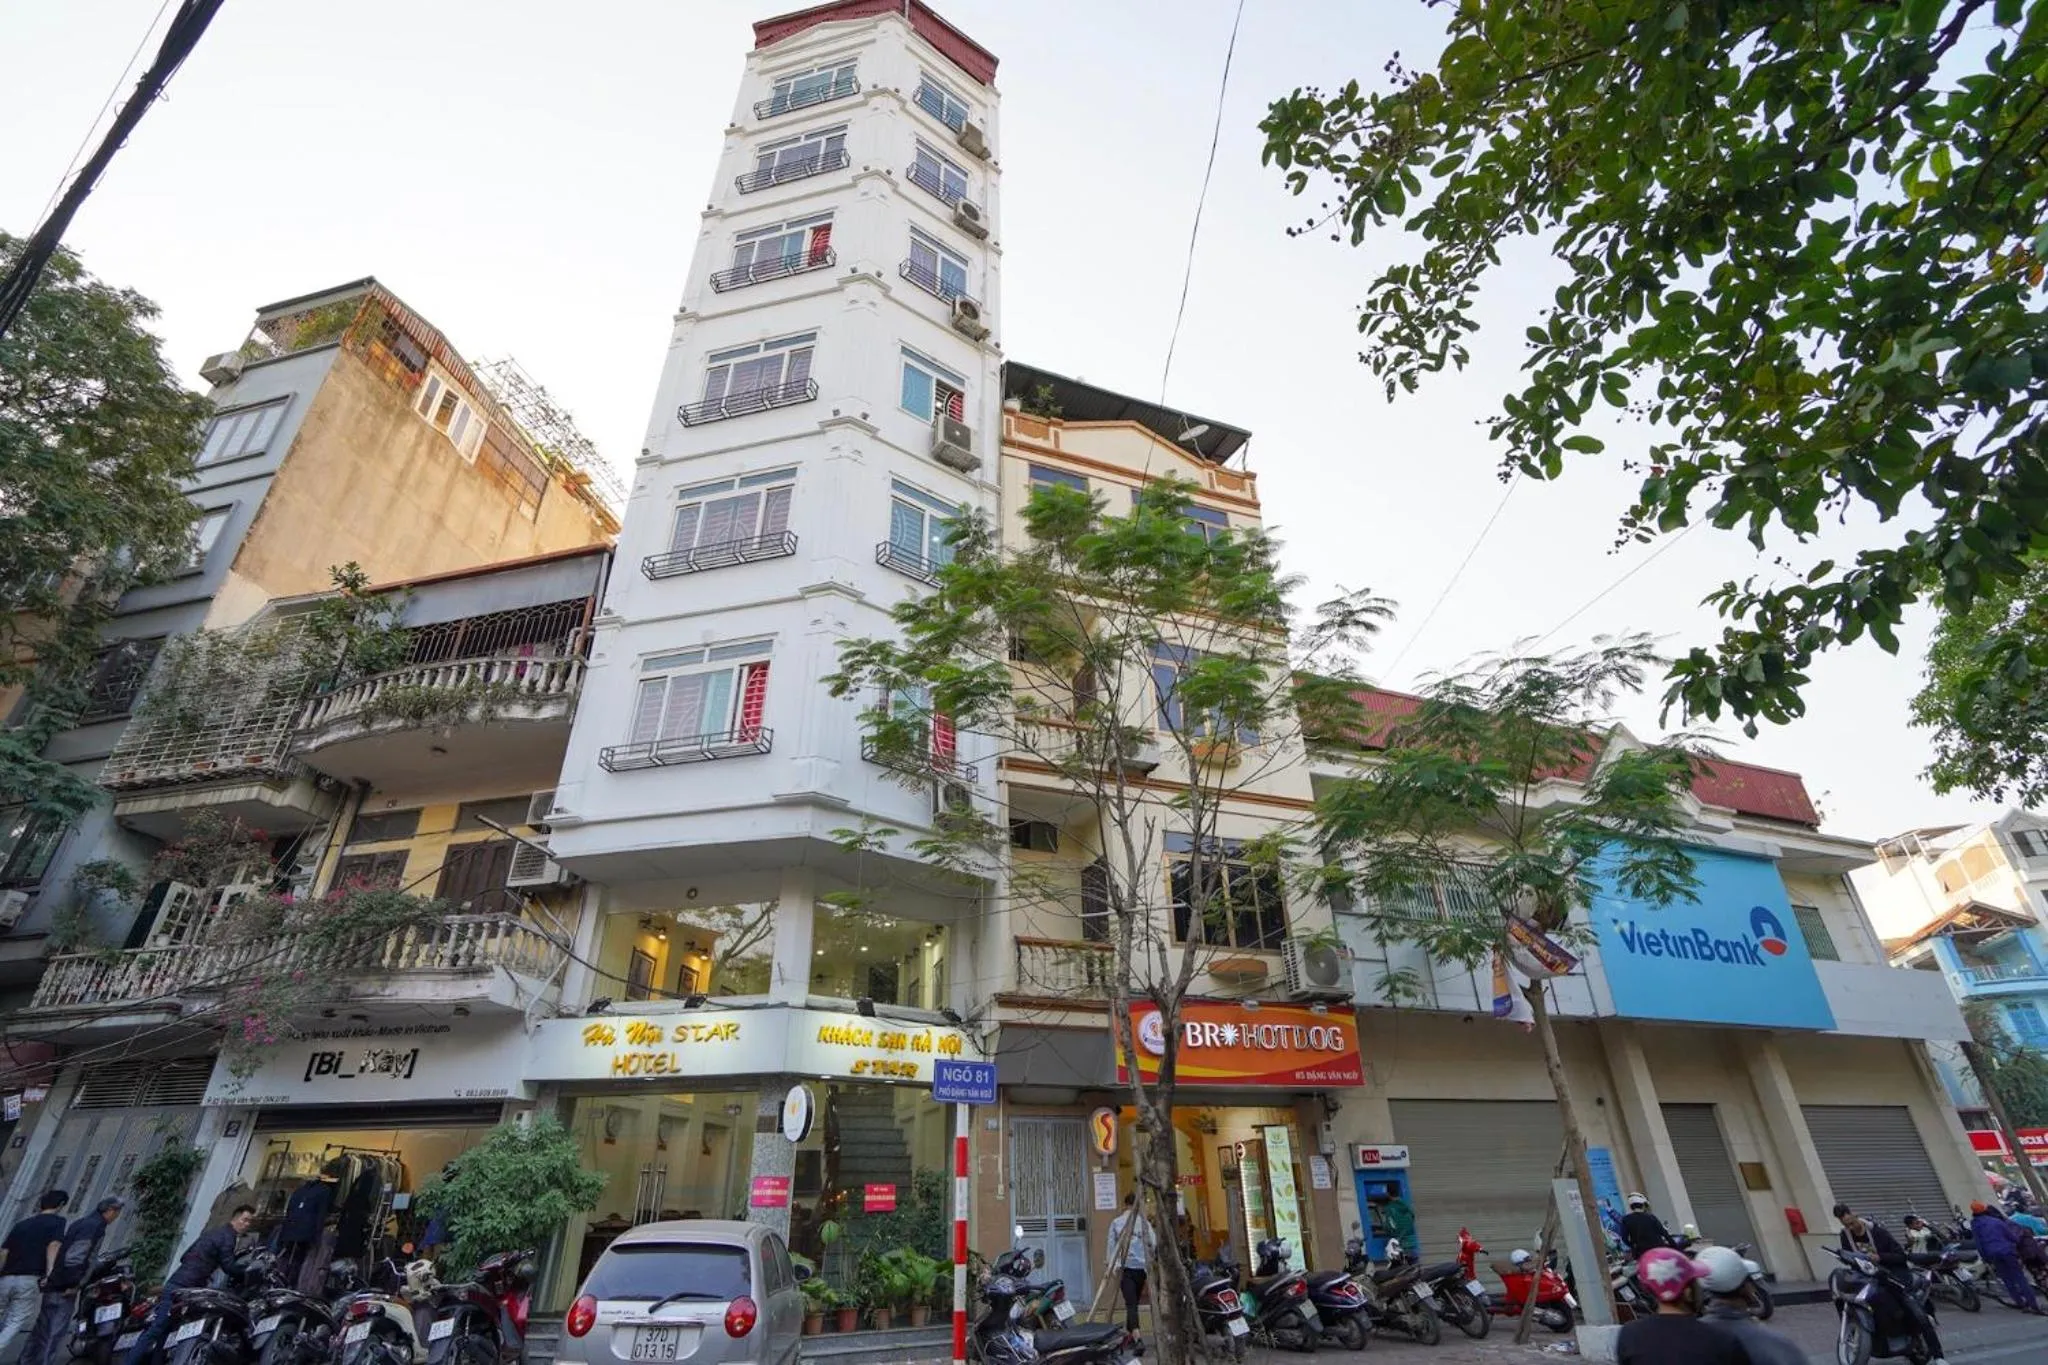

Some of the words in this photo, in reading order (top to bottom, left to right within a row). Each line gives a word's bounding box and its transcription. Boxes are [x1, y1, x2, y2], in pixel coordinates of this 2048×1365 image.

[1611, 917, 1767, 966] VietinBank
[672, 1022, 741, 1044] STAR
[611, 1051, 682, 1077] HOTEL
[976, 1070, 989, 1084] 81
